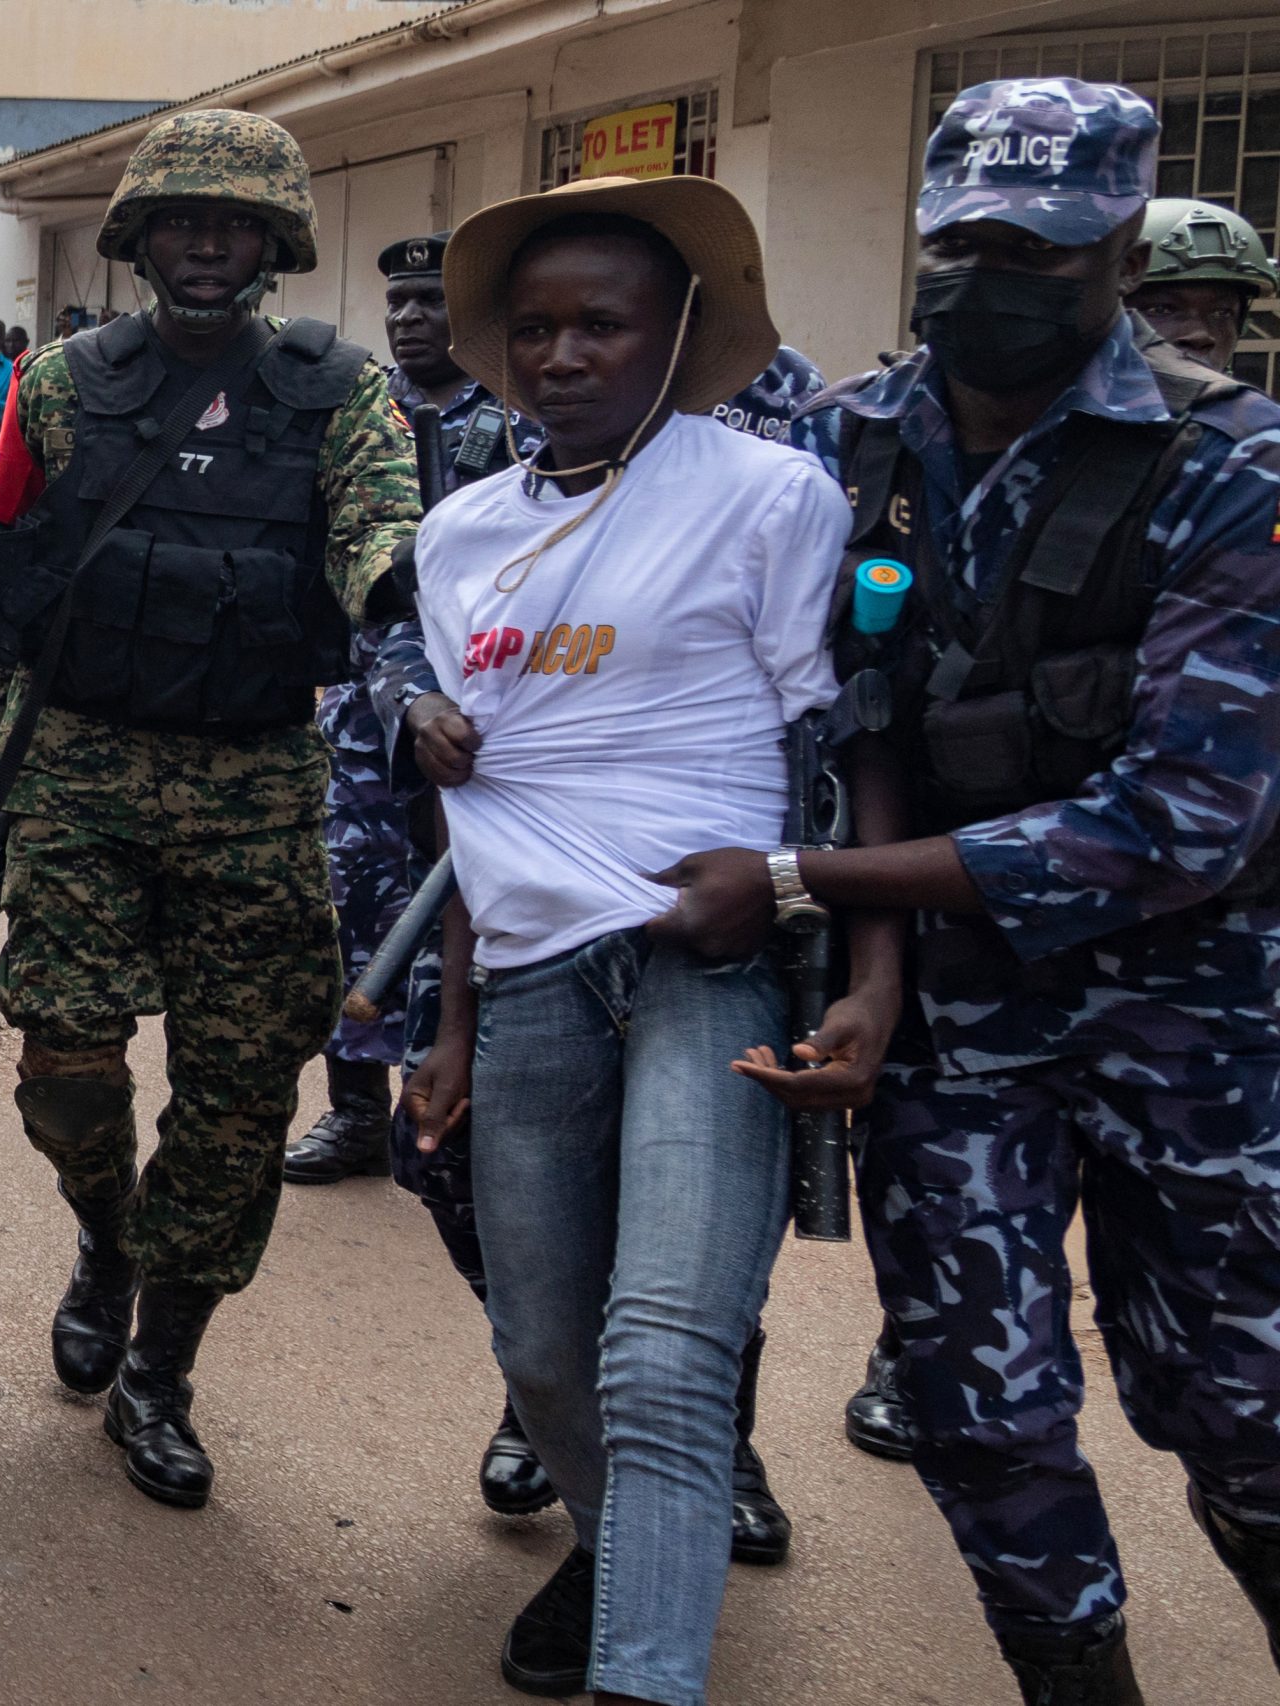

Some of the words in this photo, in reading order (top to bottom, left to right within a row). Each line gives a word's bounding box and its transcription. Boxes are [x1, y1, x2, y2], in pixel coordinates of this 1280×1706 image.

[583, 128, 607, 164] TO
[615, 115, 673, 156] LET
[962, 135, 1070, 167] POLICE
[646, 161, 669, 173] ONLY
[179, 452, 214, 474] 77
